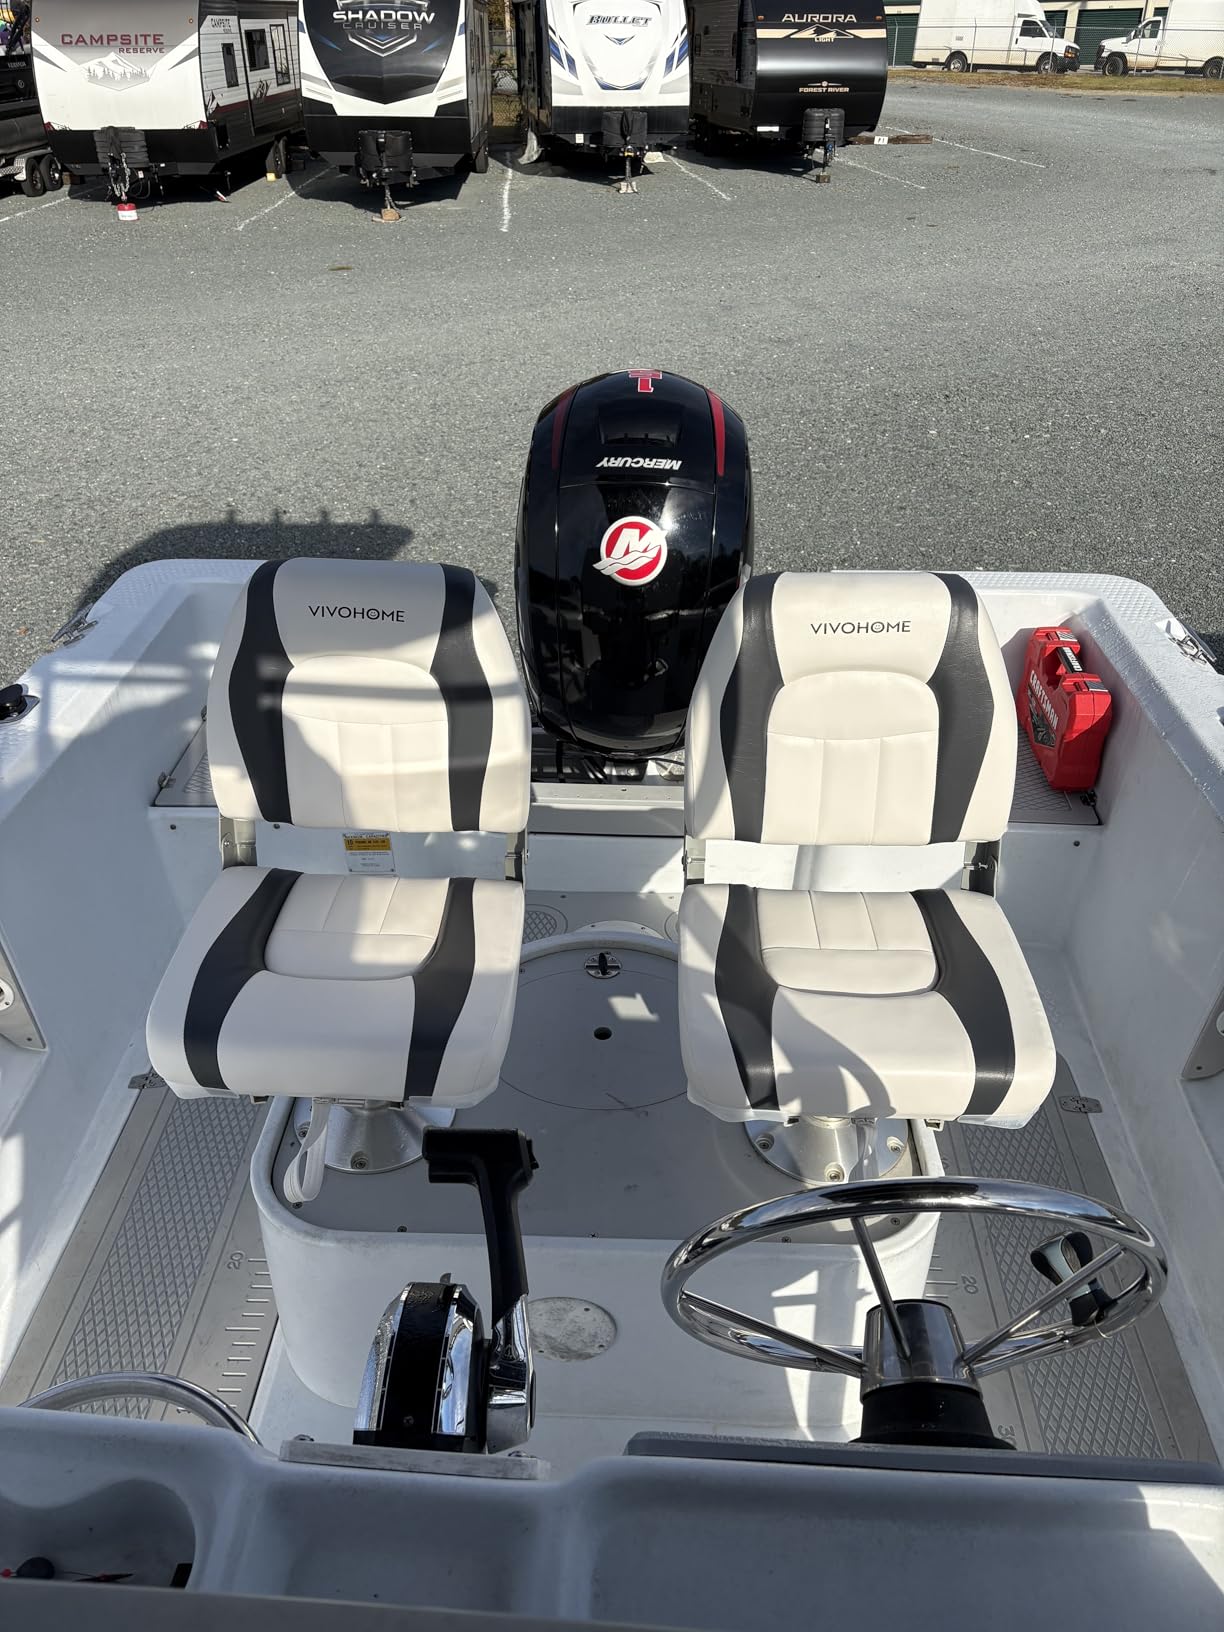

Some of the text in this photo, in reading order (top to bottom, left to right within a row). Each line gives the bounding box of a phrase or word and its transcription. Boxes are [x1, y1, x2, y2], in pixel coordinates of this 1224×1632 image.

[332, 10, 436, 25] SHADOW
[585, 14, 653, 27] BULLET
[782, 12, 857, 23] AURORA
[342, 22, 423, 30] CRUISER
[61, 33, 164, 46] CAMPSITE
[596, 456, 683, 471] MERCURY
[308, 604, 405, 623] VIVOHOME
[810, 620, 911, 635] VIVOHOME
[1029, 669, 1059, 730] CRAFTSMAN
